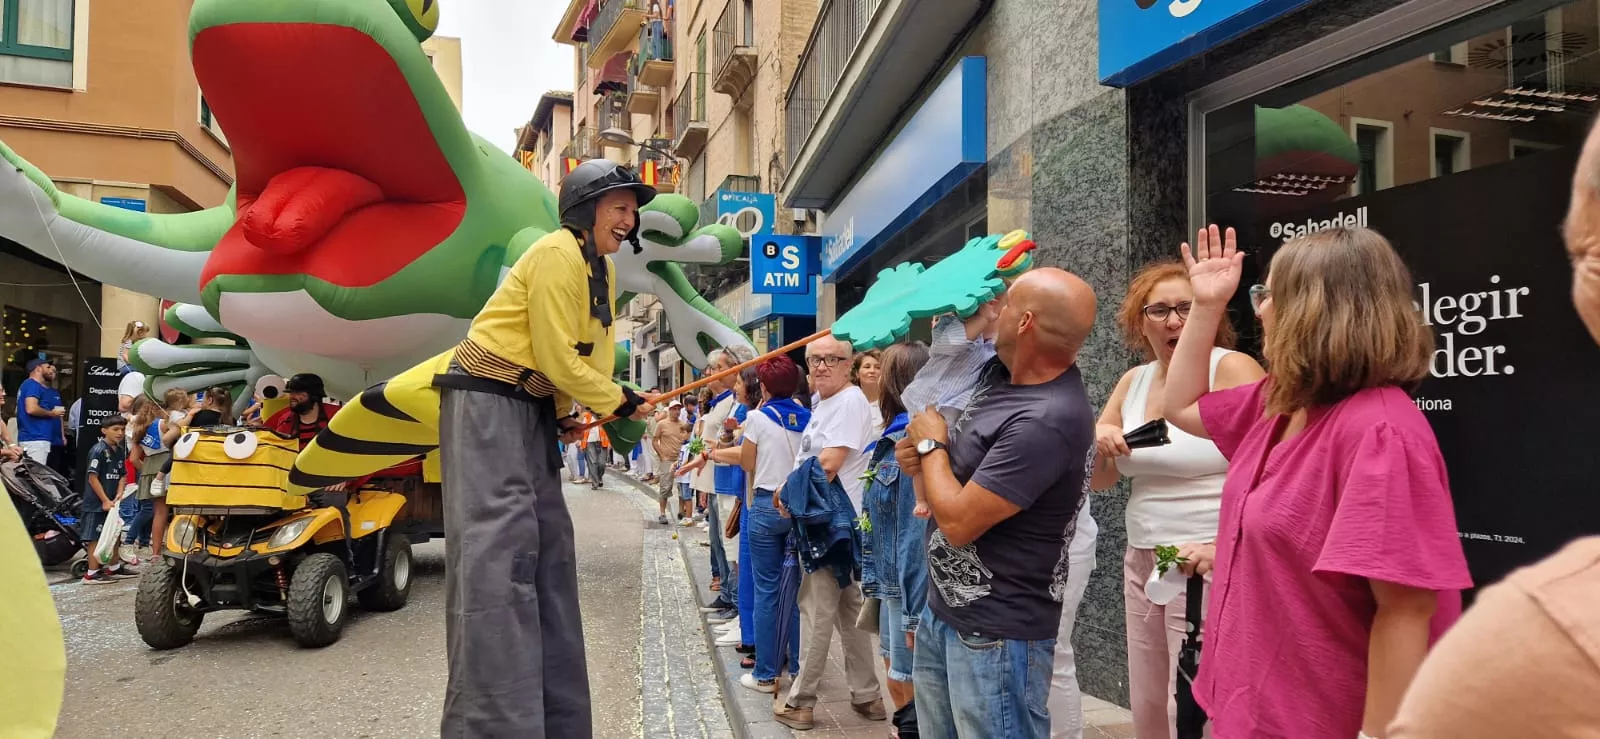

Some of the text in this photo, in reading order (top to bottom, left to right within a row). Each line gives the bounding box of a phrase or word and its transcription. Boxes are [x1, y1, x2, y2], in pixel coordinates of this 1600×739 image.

[1282, 206, 1368, 243] Sabadell
[781, 245, 800, 270] S
[763, 272, 800, 287] ATM
[1413, 274, 1530, 336] legir
[1413, 396, 1453, 411] tiona
